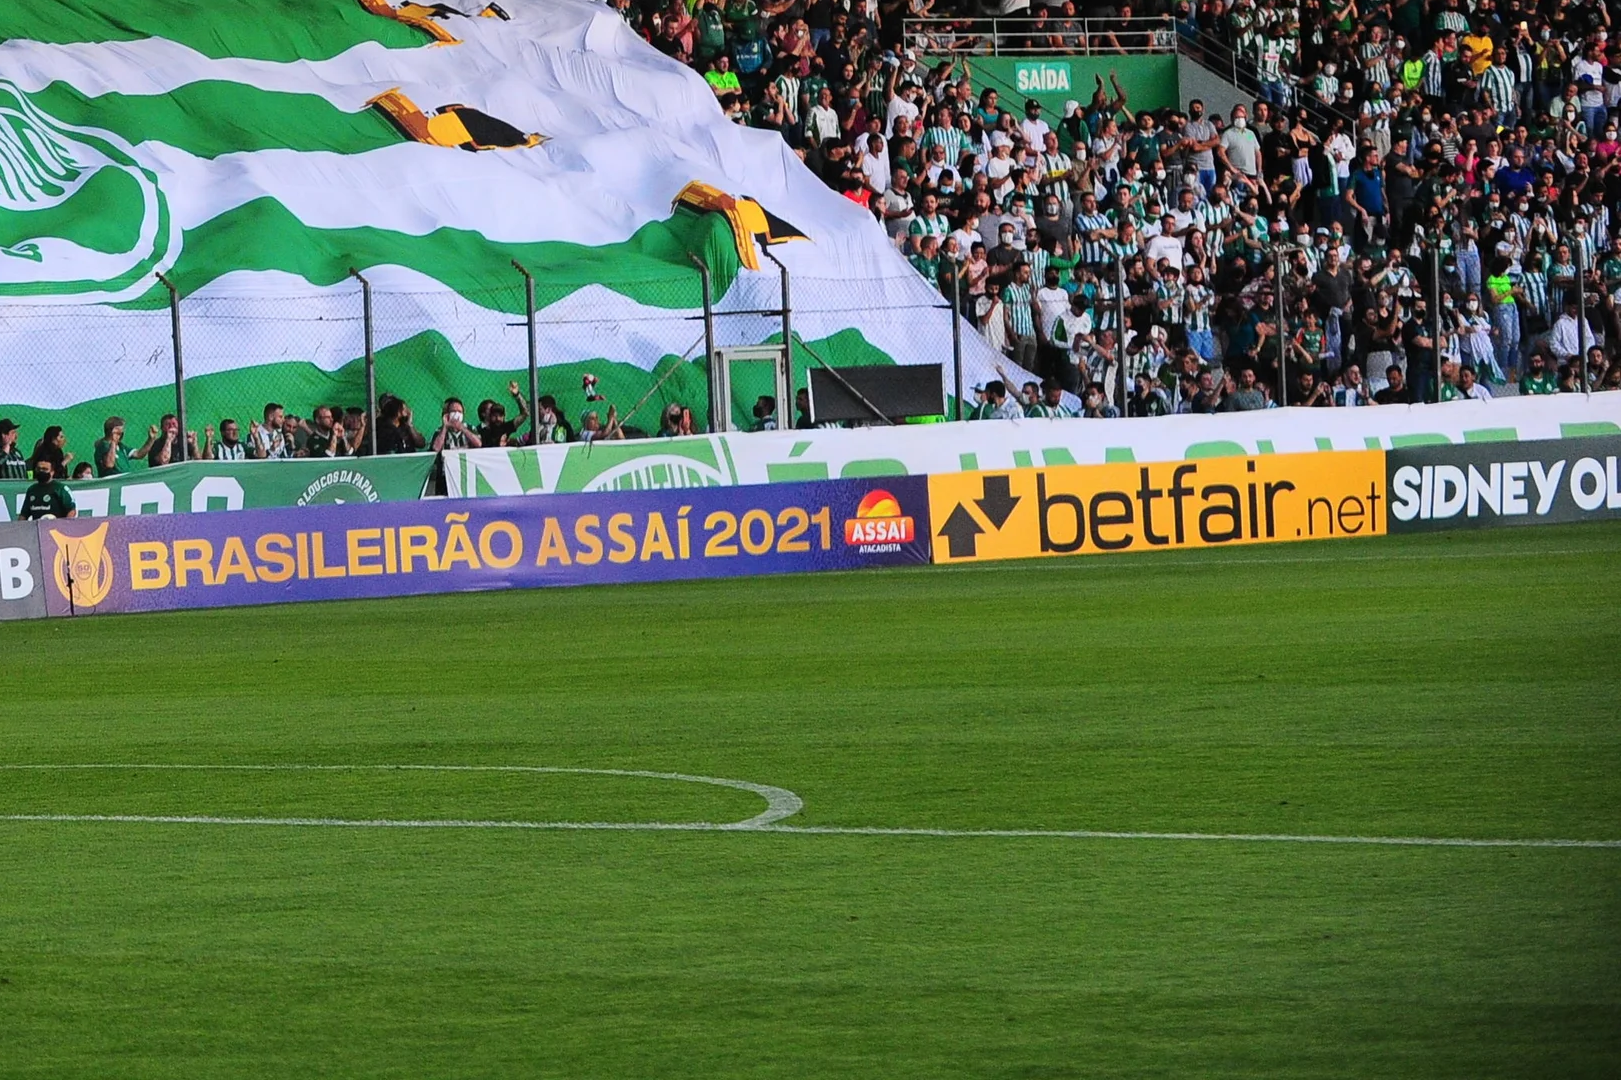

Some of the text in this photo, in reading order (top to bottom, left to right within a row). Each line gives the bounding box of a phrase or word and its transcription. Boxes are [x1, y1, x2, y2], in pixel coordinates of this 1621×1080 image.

[1018, 63, 1070, 90] SAÍDA
[302, 470, 340, 503] LOUCOS
[339, 470, 354, 483] DA
[351, 472, 381, 503] PAPAD
[1391, 459, 1566, 521] SIDNEY
[852, 518, 907, 543] ASSAÍ
[128, 505, 832, 591] BRASILEIRÃO ASSAÍ 2021
[859, 543, 902, 554] ATACADISTA
